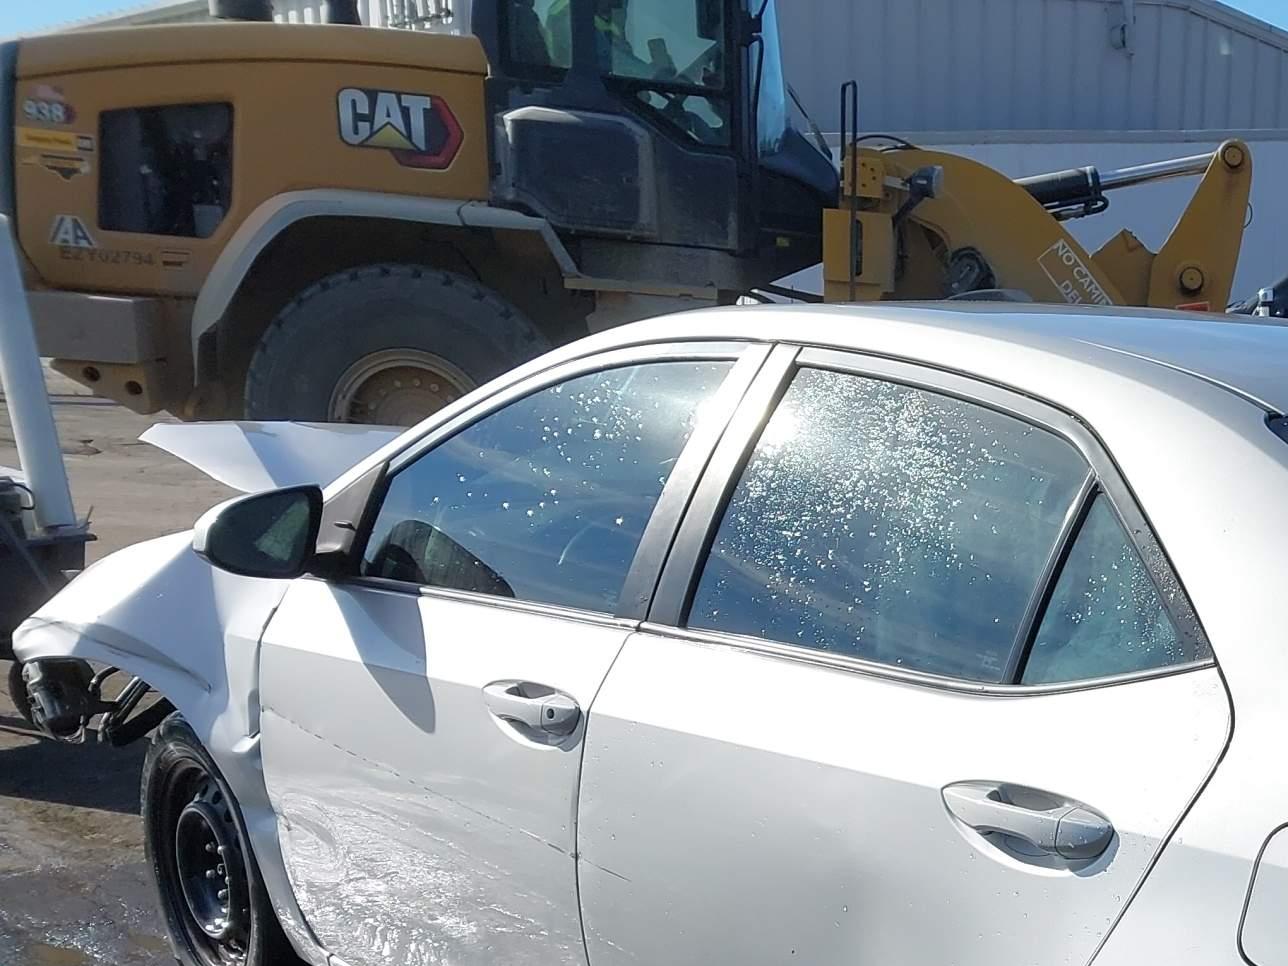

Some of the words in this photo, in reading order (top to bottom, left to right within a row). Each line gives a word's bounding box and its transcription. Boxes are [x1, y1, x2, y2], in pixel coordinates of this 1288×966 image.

[23, 99, 65, 122] 938
[338, 87, 431, 151] CAT
[1055, 240, 1075, 265] NO
